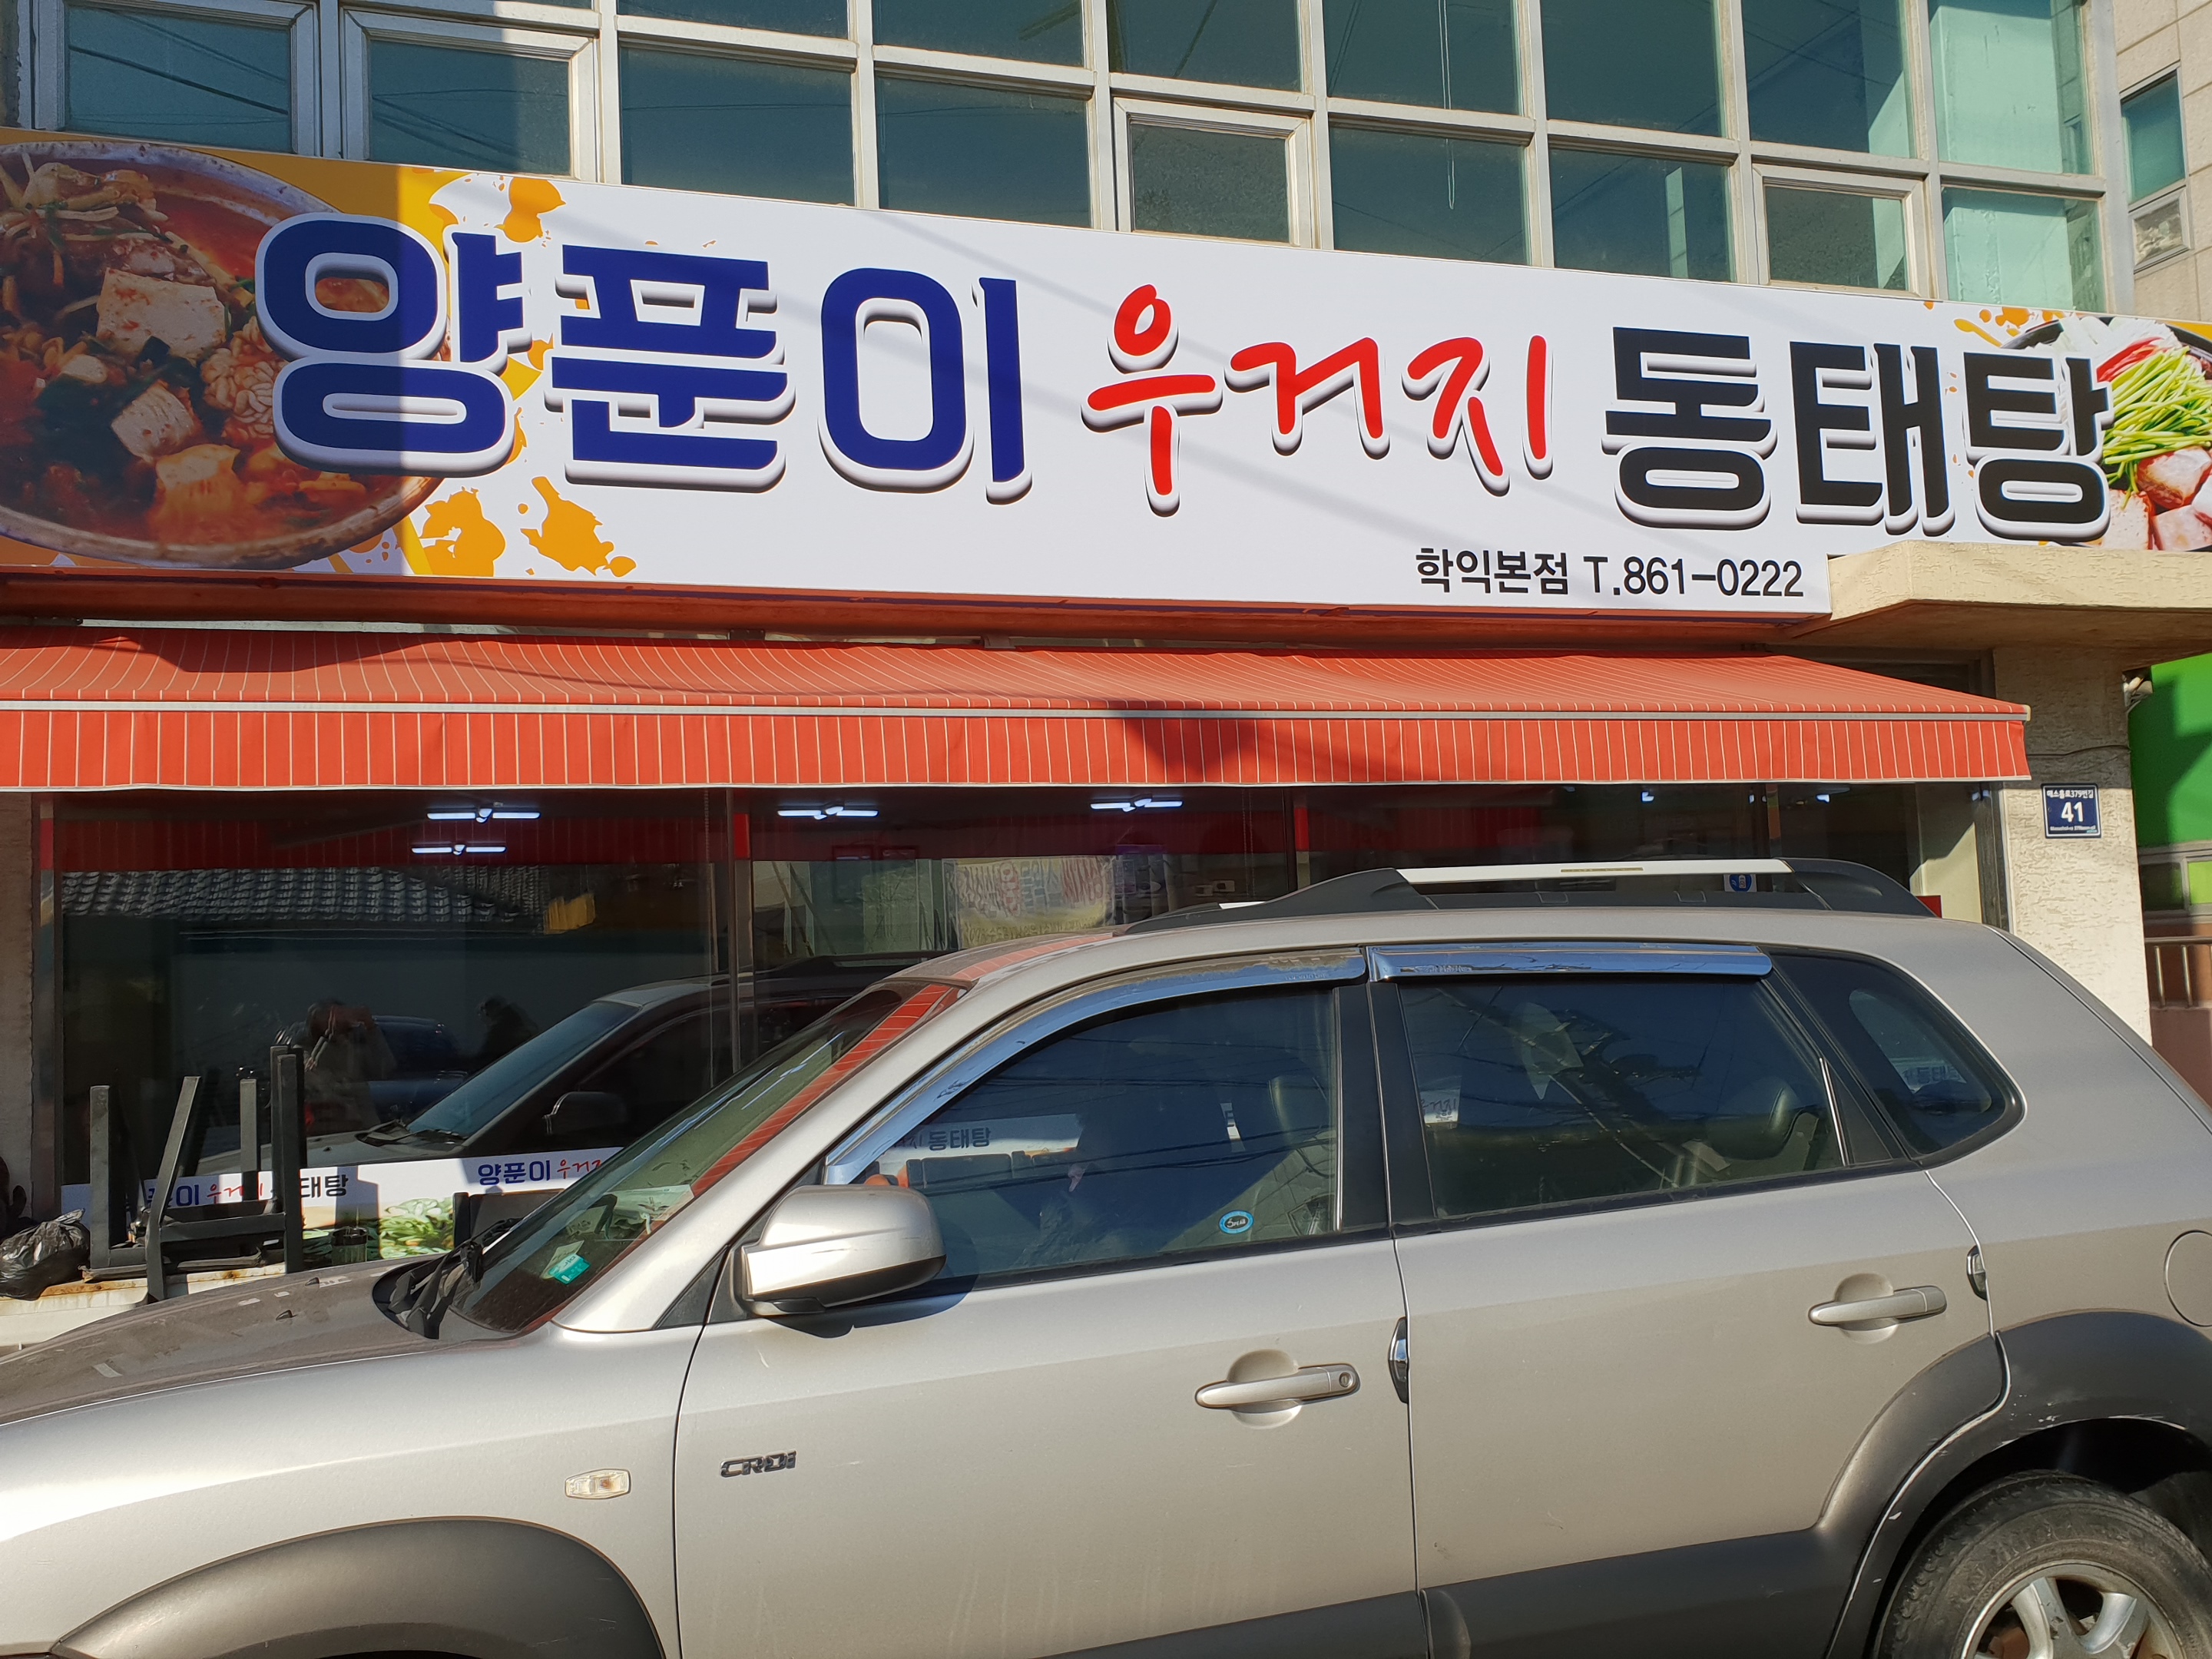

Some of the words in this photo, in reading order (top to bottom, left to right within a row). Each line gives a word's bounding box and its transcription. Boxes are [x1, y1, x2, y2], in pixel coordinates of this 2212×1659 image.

[257, 214, 1031, 503] 양푼이
[1081, 284, 1553, 517] 우거지
[1601, 326, 2114, 541] 동태탕
[1416, 548, 1568, 595] 학익본점
[1583, 556, 1804, 598] T.861-0222
[2061, 801, 2084, 823] 41
[929, 1127, 991, 1151] 동태탕
[478, 1160, 551, 1186] 양푼이
[300, 1174, 349, 1198] 태탕
